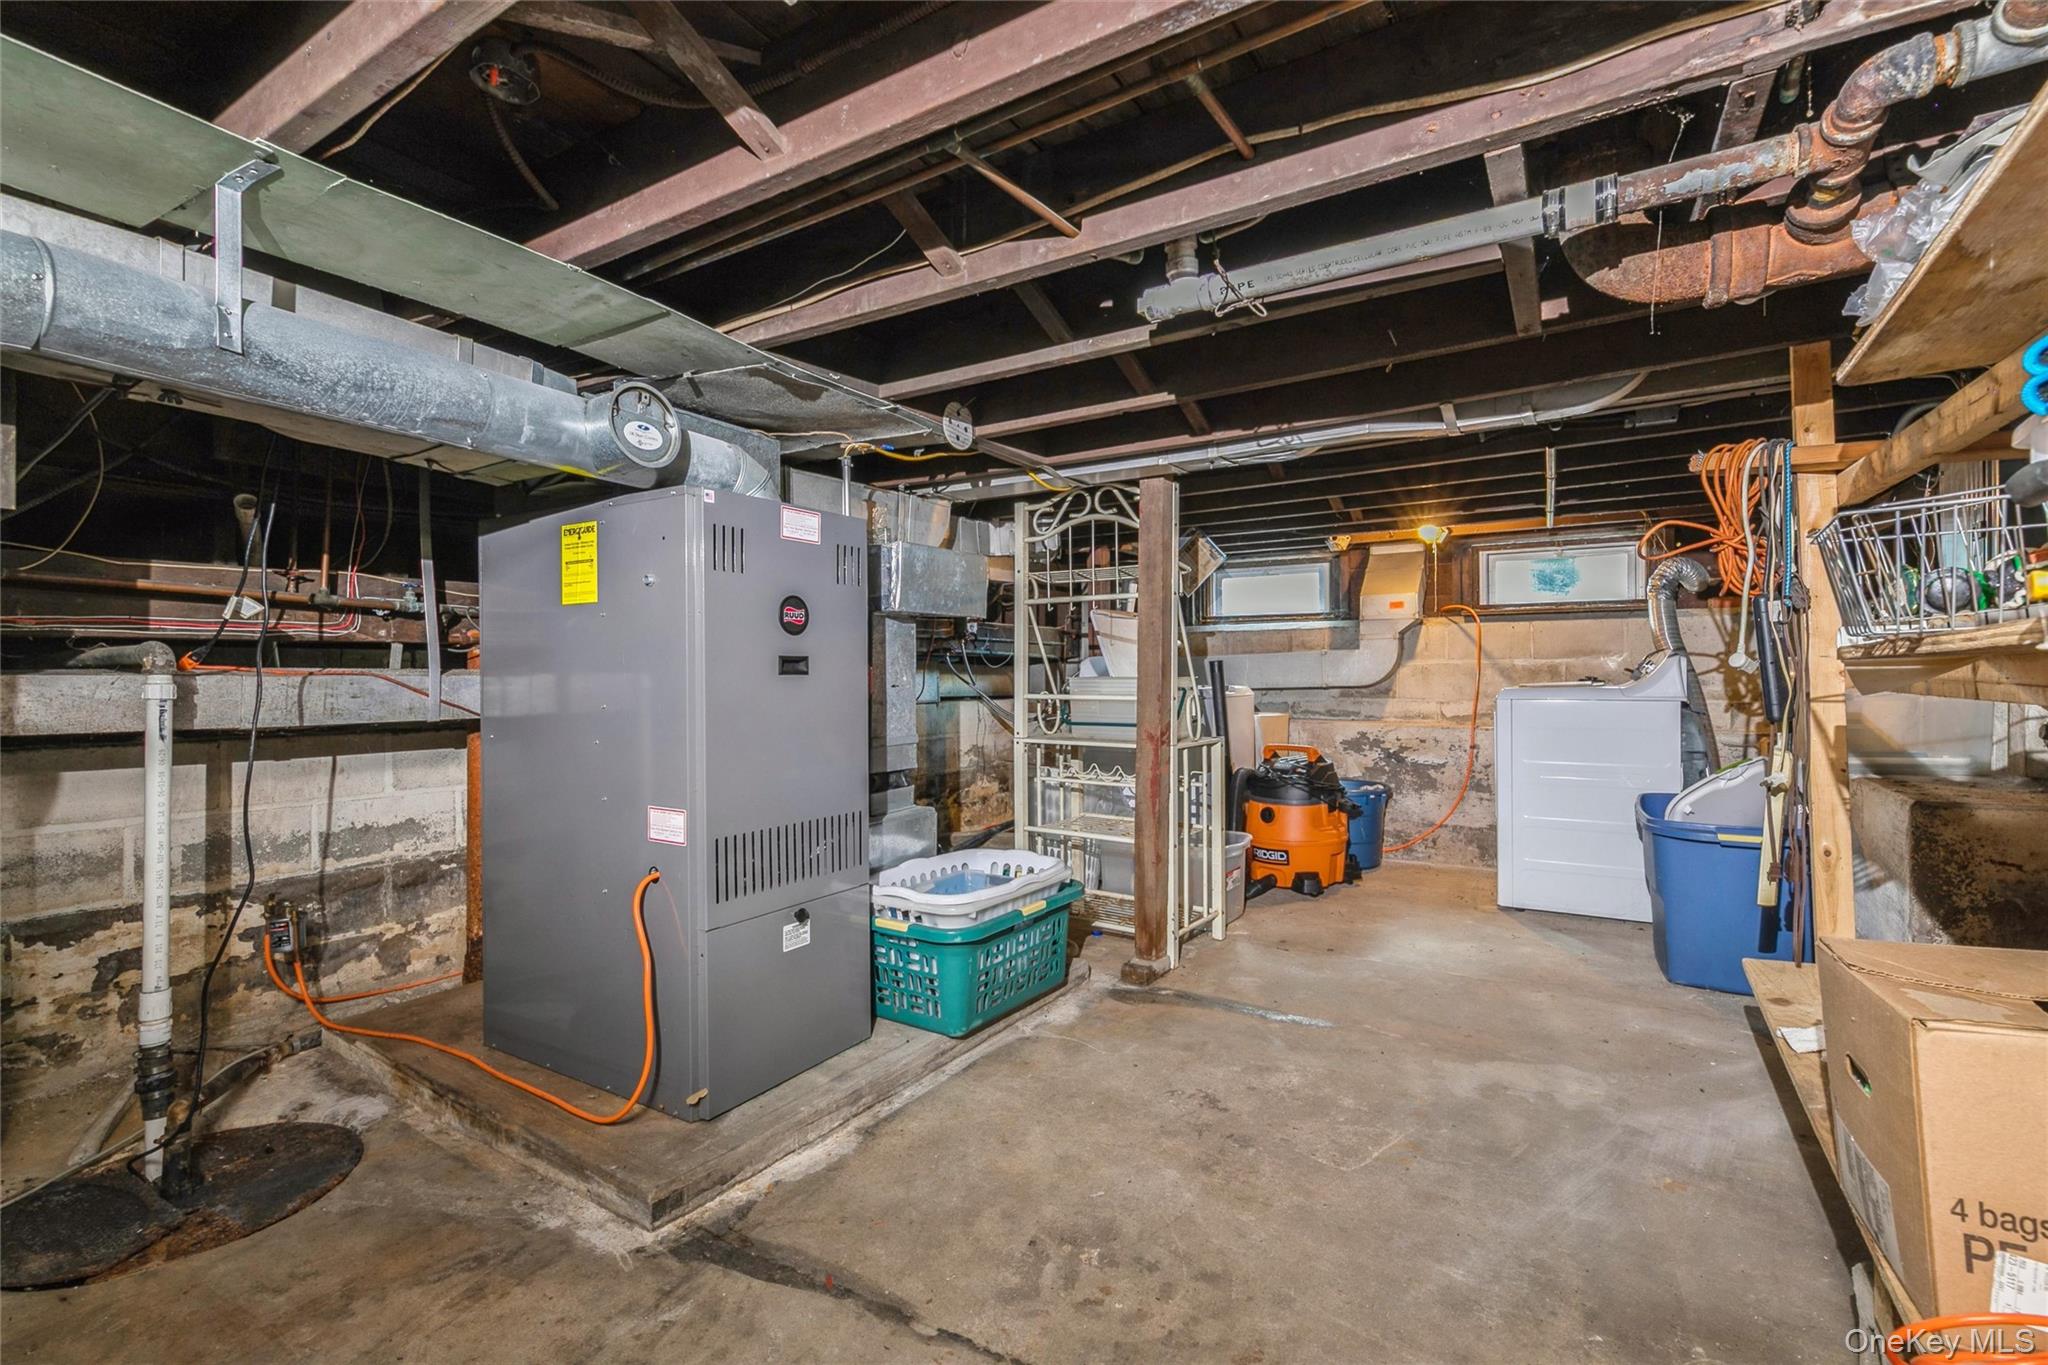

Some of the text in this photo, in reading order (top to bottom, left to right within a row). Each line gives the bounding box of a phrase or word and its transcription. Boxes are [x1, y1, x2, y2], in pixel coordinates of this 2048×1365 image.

[1220, 280, 1254, 295] PPE
[784, 611, 804, 619] RUUD
[1254, 848, 1287, 860] RIDGID
[1950, 1198, 2048, 1243] 4 bags
[1963, 1233, 2028, 1274] P
